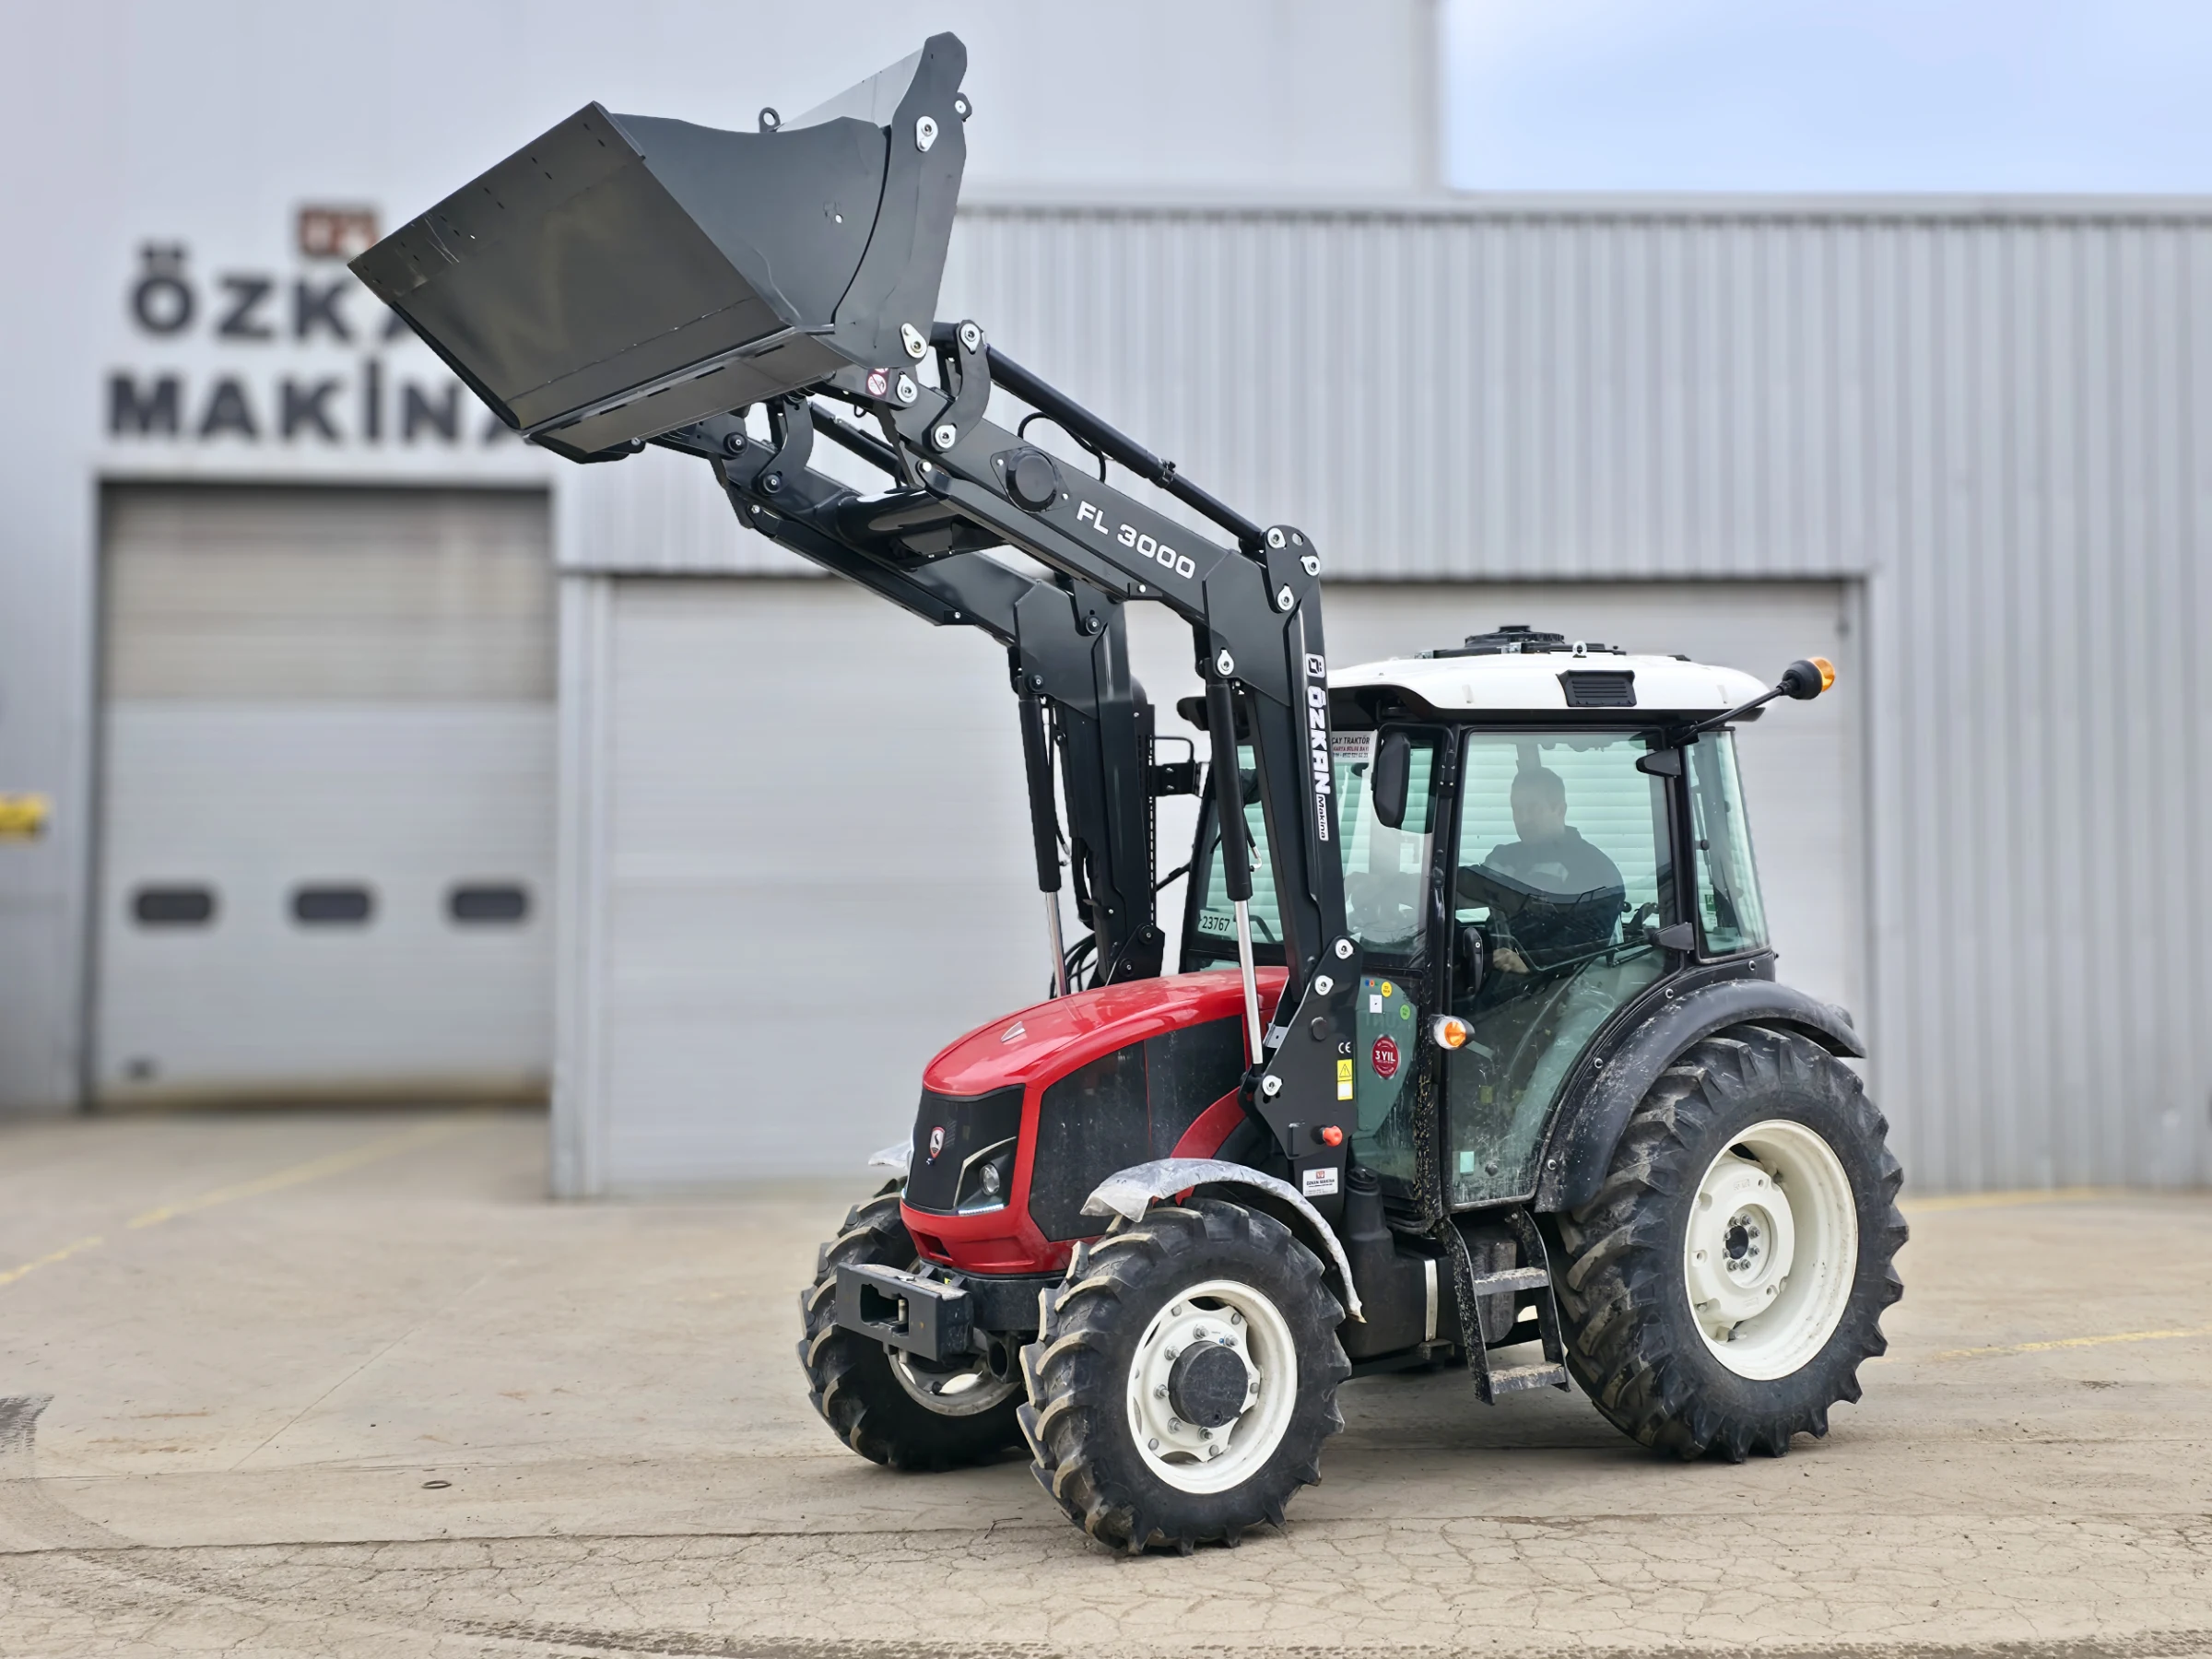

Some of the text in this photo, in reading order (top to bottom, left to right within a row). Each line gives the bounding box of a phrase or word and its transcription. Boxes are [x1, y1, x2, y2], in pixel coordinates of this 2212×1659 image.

[1077, 500, 1195, 579] FL 3000
[1308, 686, 1331, 794] ÖZKAN
[1317, 795, 1327, 839] Makina
[1202, 915, 1230, 932] 23767
[1338, 1041, 1351, 1053] CE
[1375, 1050, 1396, 1062] 3 YIL
